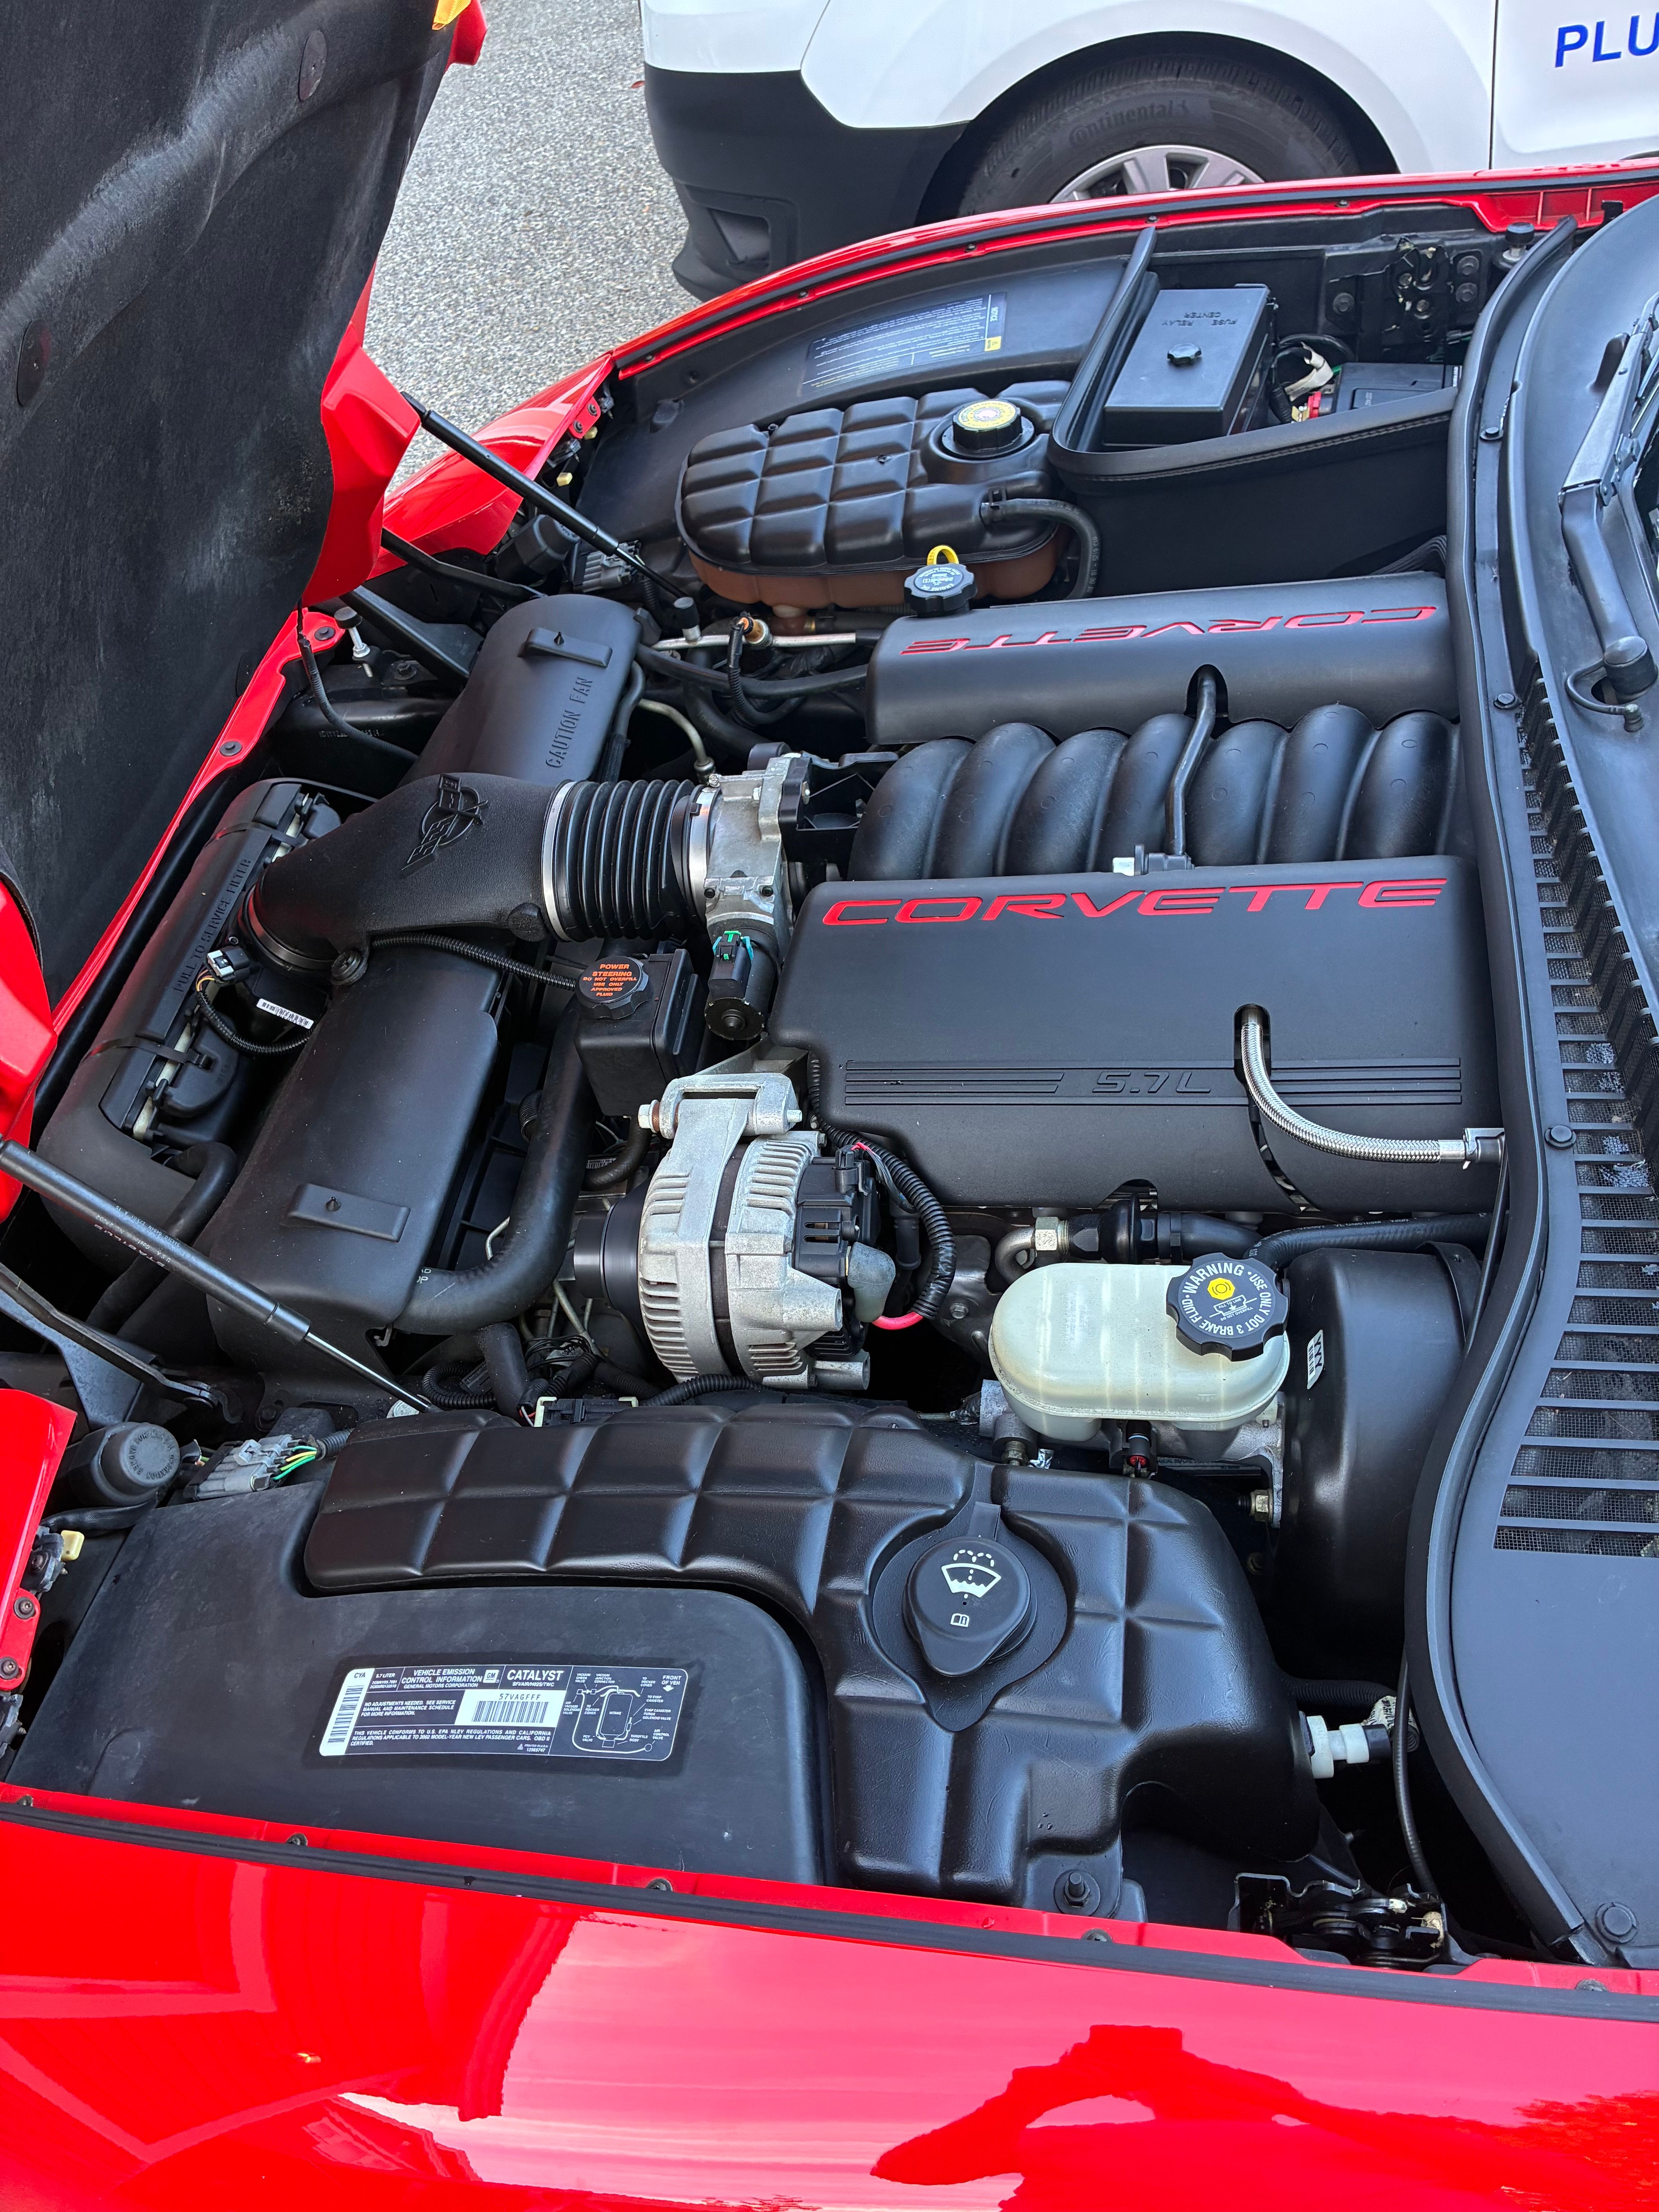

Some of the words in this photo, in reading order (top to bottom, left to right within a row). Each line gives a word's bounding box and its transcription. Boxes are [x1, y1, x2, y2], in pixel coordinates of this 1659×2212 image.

[900, 606, 1437, 654] CORVETTE
[546, 709, 581, 768] CAUTION
[569, 677, 593, 704] FAN
[823, 879, 1447, 926] CORVETTE
[173, 965, 196, 992] PULL
[190, 945, 205, 958] TO
[201, 900, 230, 943] SERVICE
[226, 859, 251, 894] FILTER
[1092, 1071, 1211, 1094] 5.7L
[1182, 1262, 1245, 1294] WARNING
[1249, 1273, 1267, 1291] USE
[1182, 1298, 1202, 1323] FLUID
[1235, 1307, 1254, 1316] OVERFILL
[1259, 1292, 1272, 1316] ONLY
[1199, 1319, 1234, 1336] BRAKE
[1236, 1324, 1244, 1334] 3
[1245, 1314, 1265, 1332] DOT
[507, 1669, 564, 1681] CATALYST
